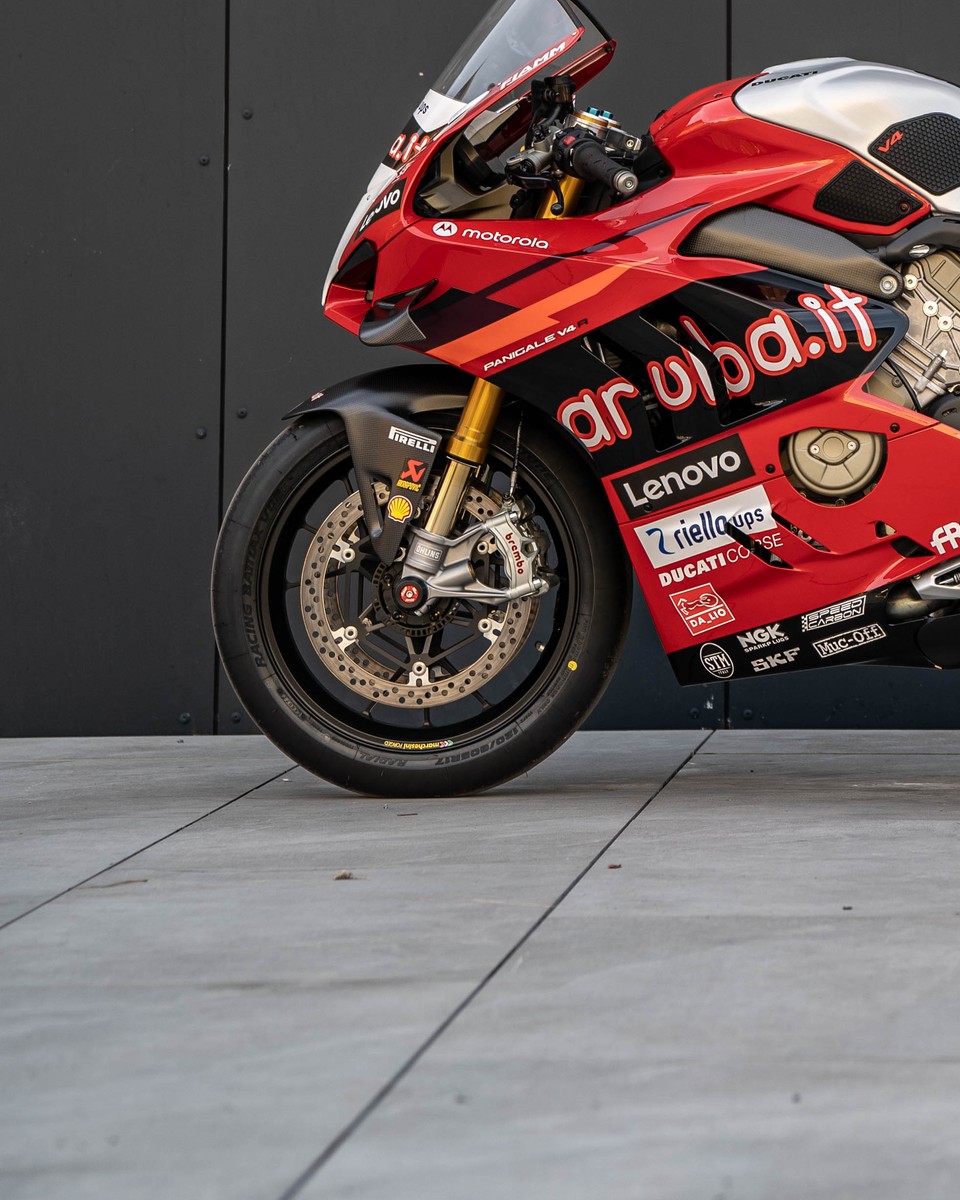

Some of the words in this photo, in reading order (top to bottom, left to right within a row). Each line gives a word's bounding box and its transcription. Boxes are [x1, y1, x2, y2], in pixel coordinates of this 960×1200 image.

[499, 41, 566, 90] FIAMM
[751, 70, 818, 87] DUCATI
[878, 130, 904, 153] V4
[461, 228, 549, 249] motorola
[483, 333, 557, 371] PANIGALE
[557, 324, 577, 337] V4
[577, 318, 589, 328] R
[558, 284, 876, 451] aruba.it
[388, 425, 437, 453] PIRELLI
[623, 450, 741, 508] Lenovo
[673, 510, 729, 550] riello
[733, 507, 764, 529] ups
[505, 532, 524, 574] brembo
[658, 552, 727, 587] DUCATI
[726, 533, 784, 563] COSE
[808, 599, 863, 620] SPEED
[808, 608, 863, 630] CARBON
[736, 623, 787, 648] NGK
[817, 625, 883, 656] Muc-Off
[704, 650, 732, 670] STM
[750, 647, 800, 673] SKF
[358, 750, 408, 768] RADIAL
